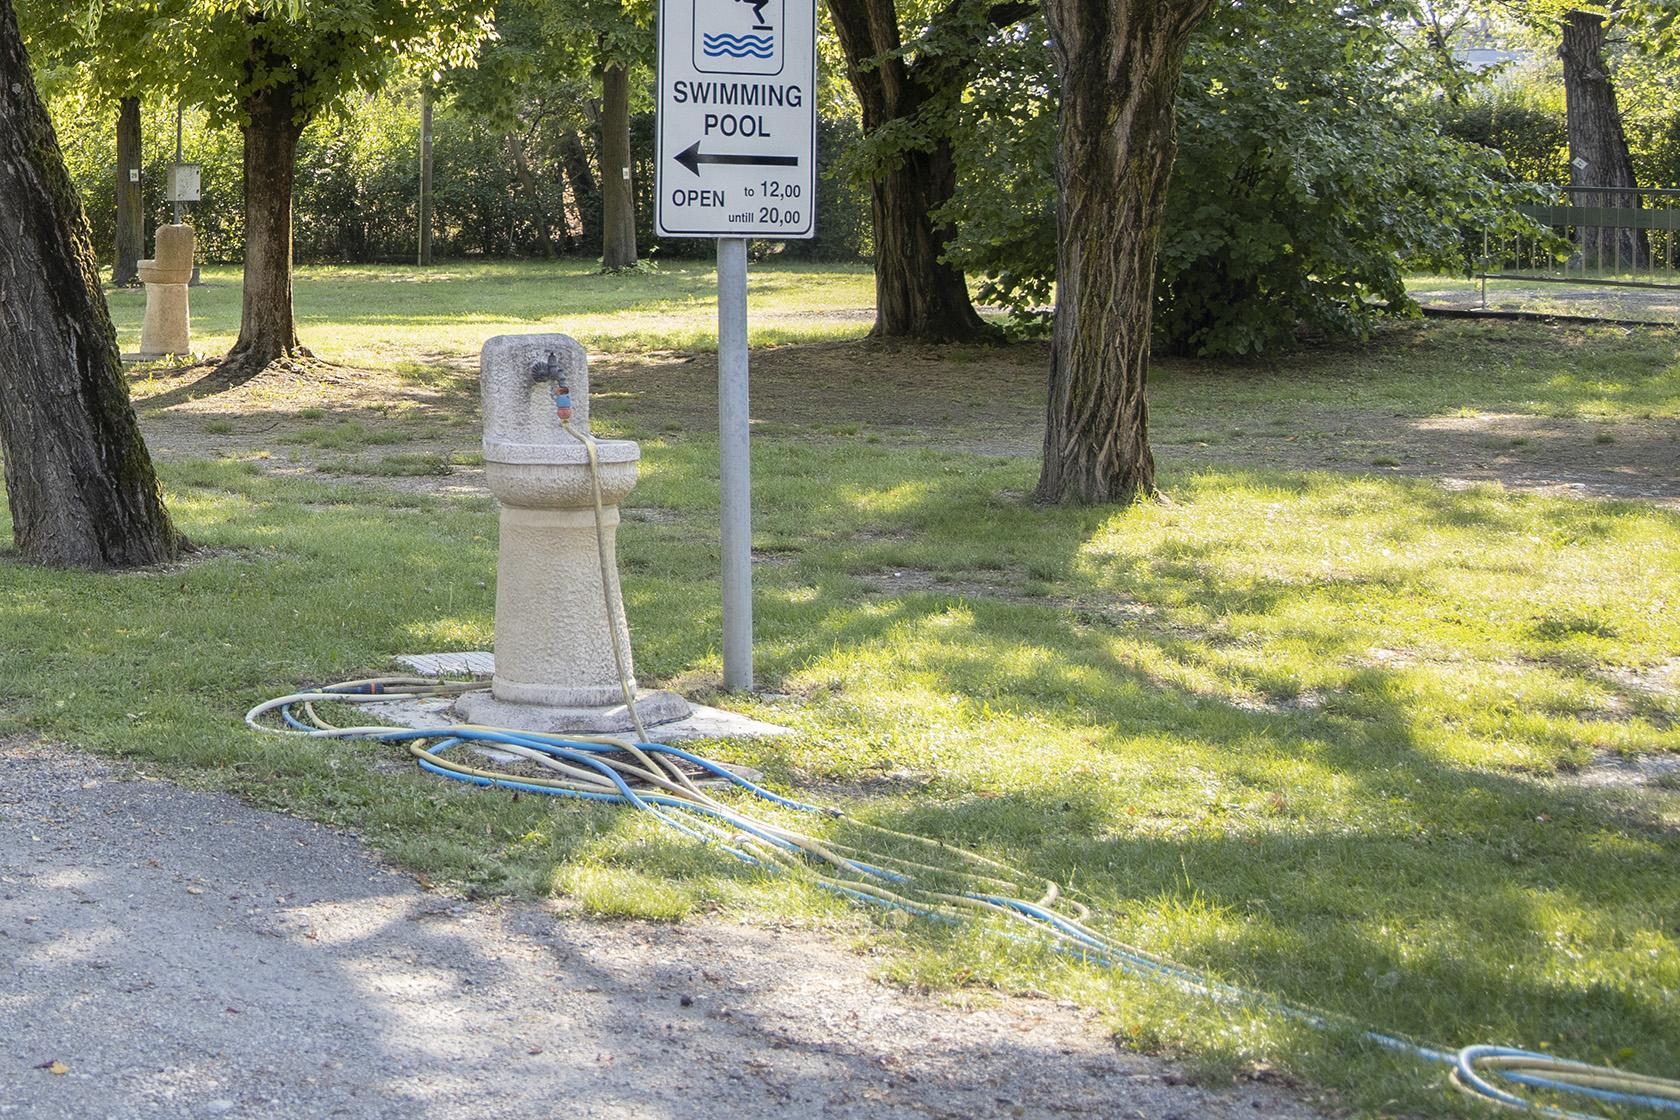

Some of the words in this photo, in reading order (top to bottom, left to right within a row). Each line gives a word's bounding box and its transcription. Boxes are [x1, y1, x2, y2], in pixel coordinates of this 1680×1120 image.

[673, 80, 802, 108] SWIMMING
[704, 113, 771, 138] POOL
[672, 189, 725, 208] OPEN
[744, 186, 755, 198] to
[760, 180, 801, 201] 12,00
[728, 212, 754, 223] untill
[759, 206, 801, 227] 20,00
